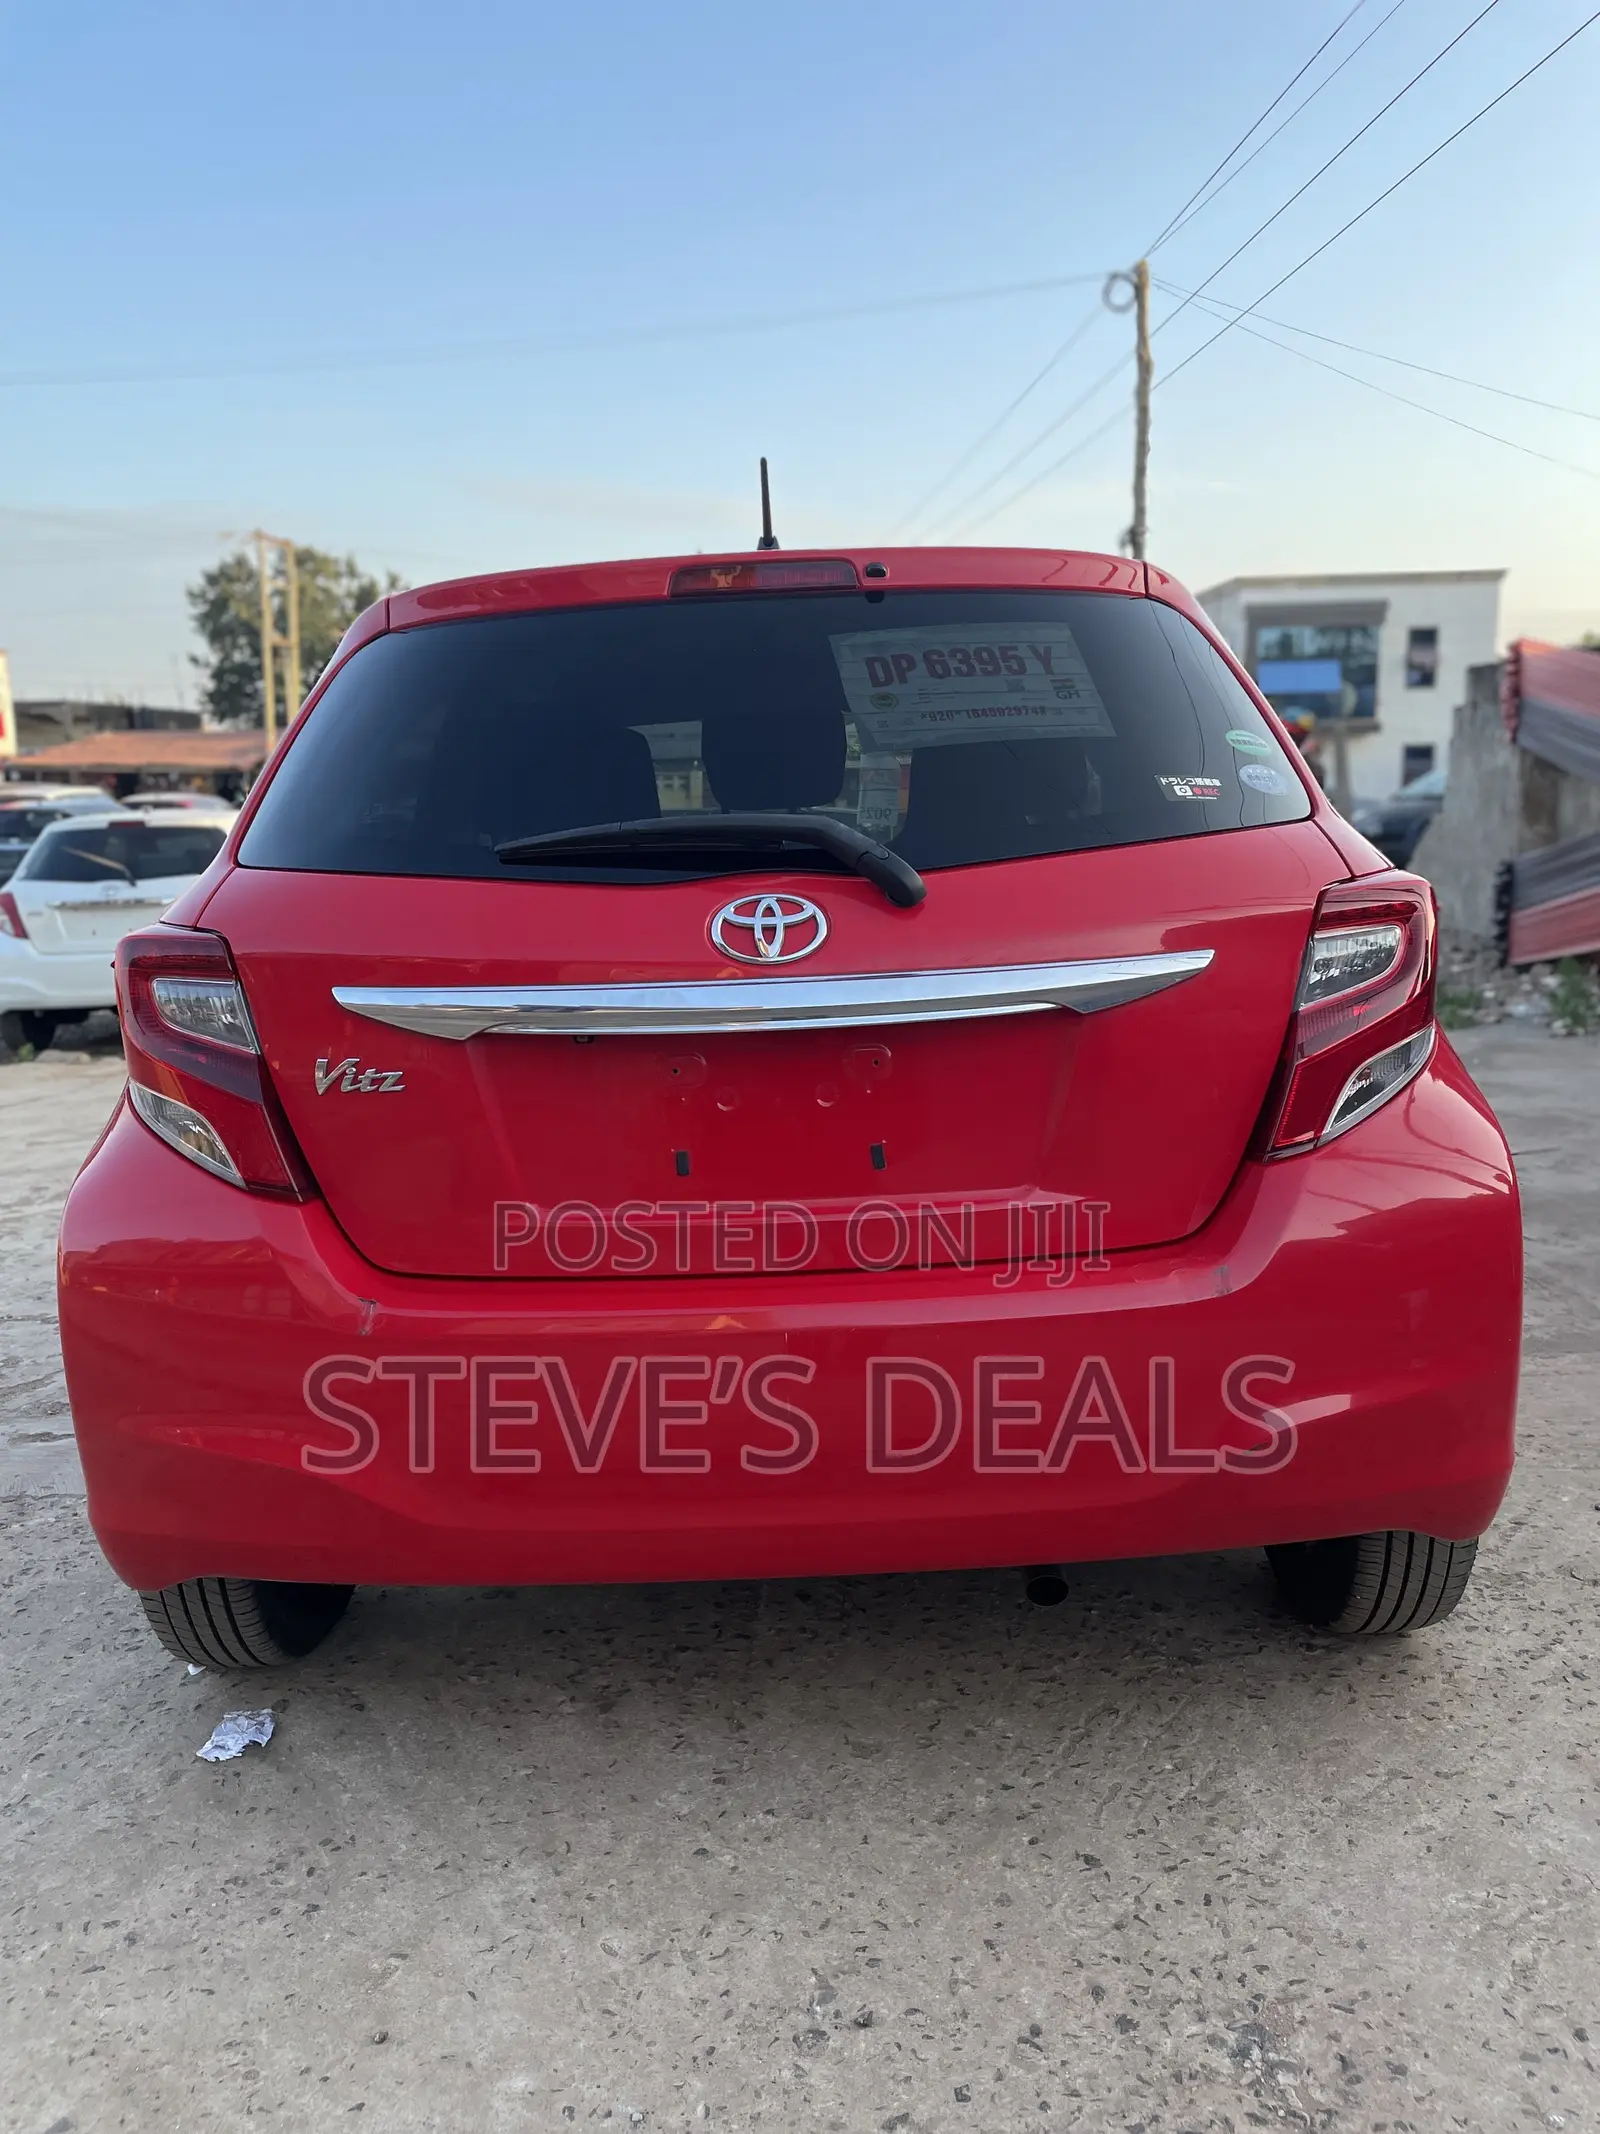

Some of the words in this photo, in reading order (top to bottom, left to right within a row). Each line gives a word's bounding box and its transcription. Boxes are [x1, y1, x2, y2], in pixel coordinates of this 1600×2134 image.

[864, 652, 917, 688] DP
[921, 645, 1027, 680] 6395
[1027, 645, 1055, 676] Y
[1203, 787, 1221, 796] REC
[314, 1058, 406, 1096] Vitz
